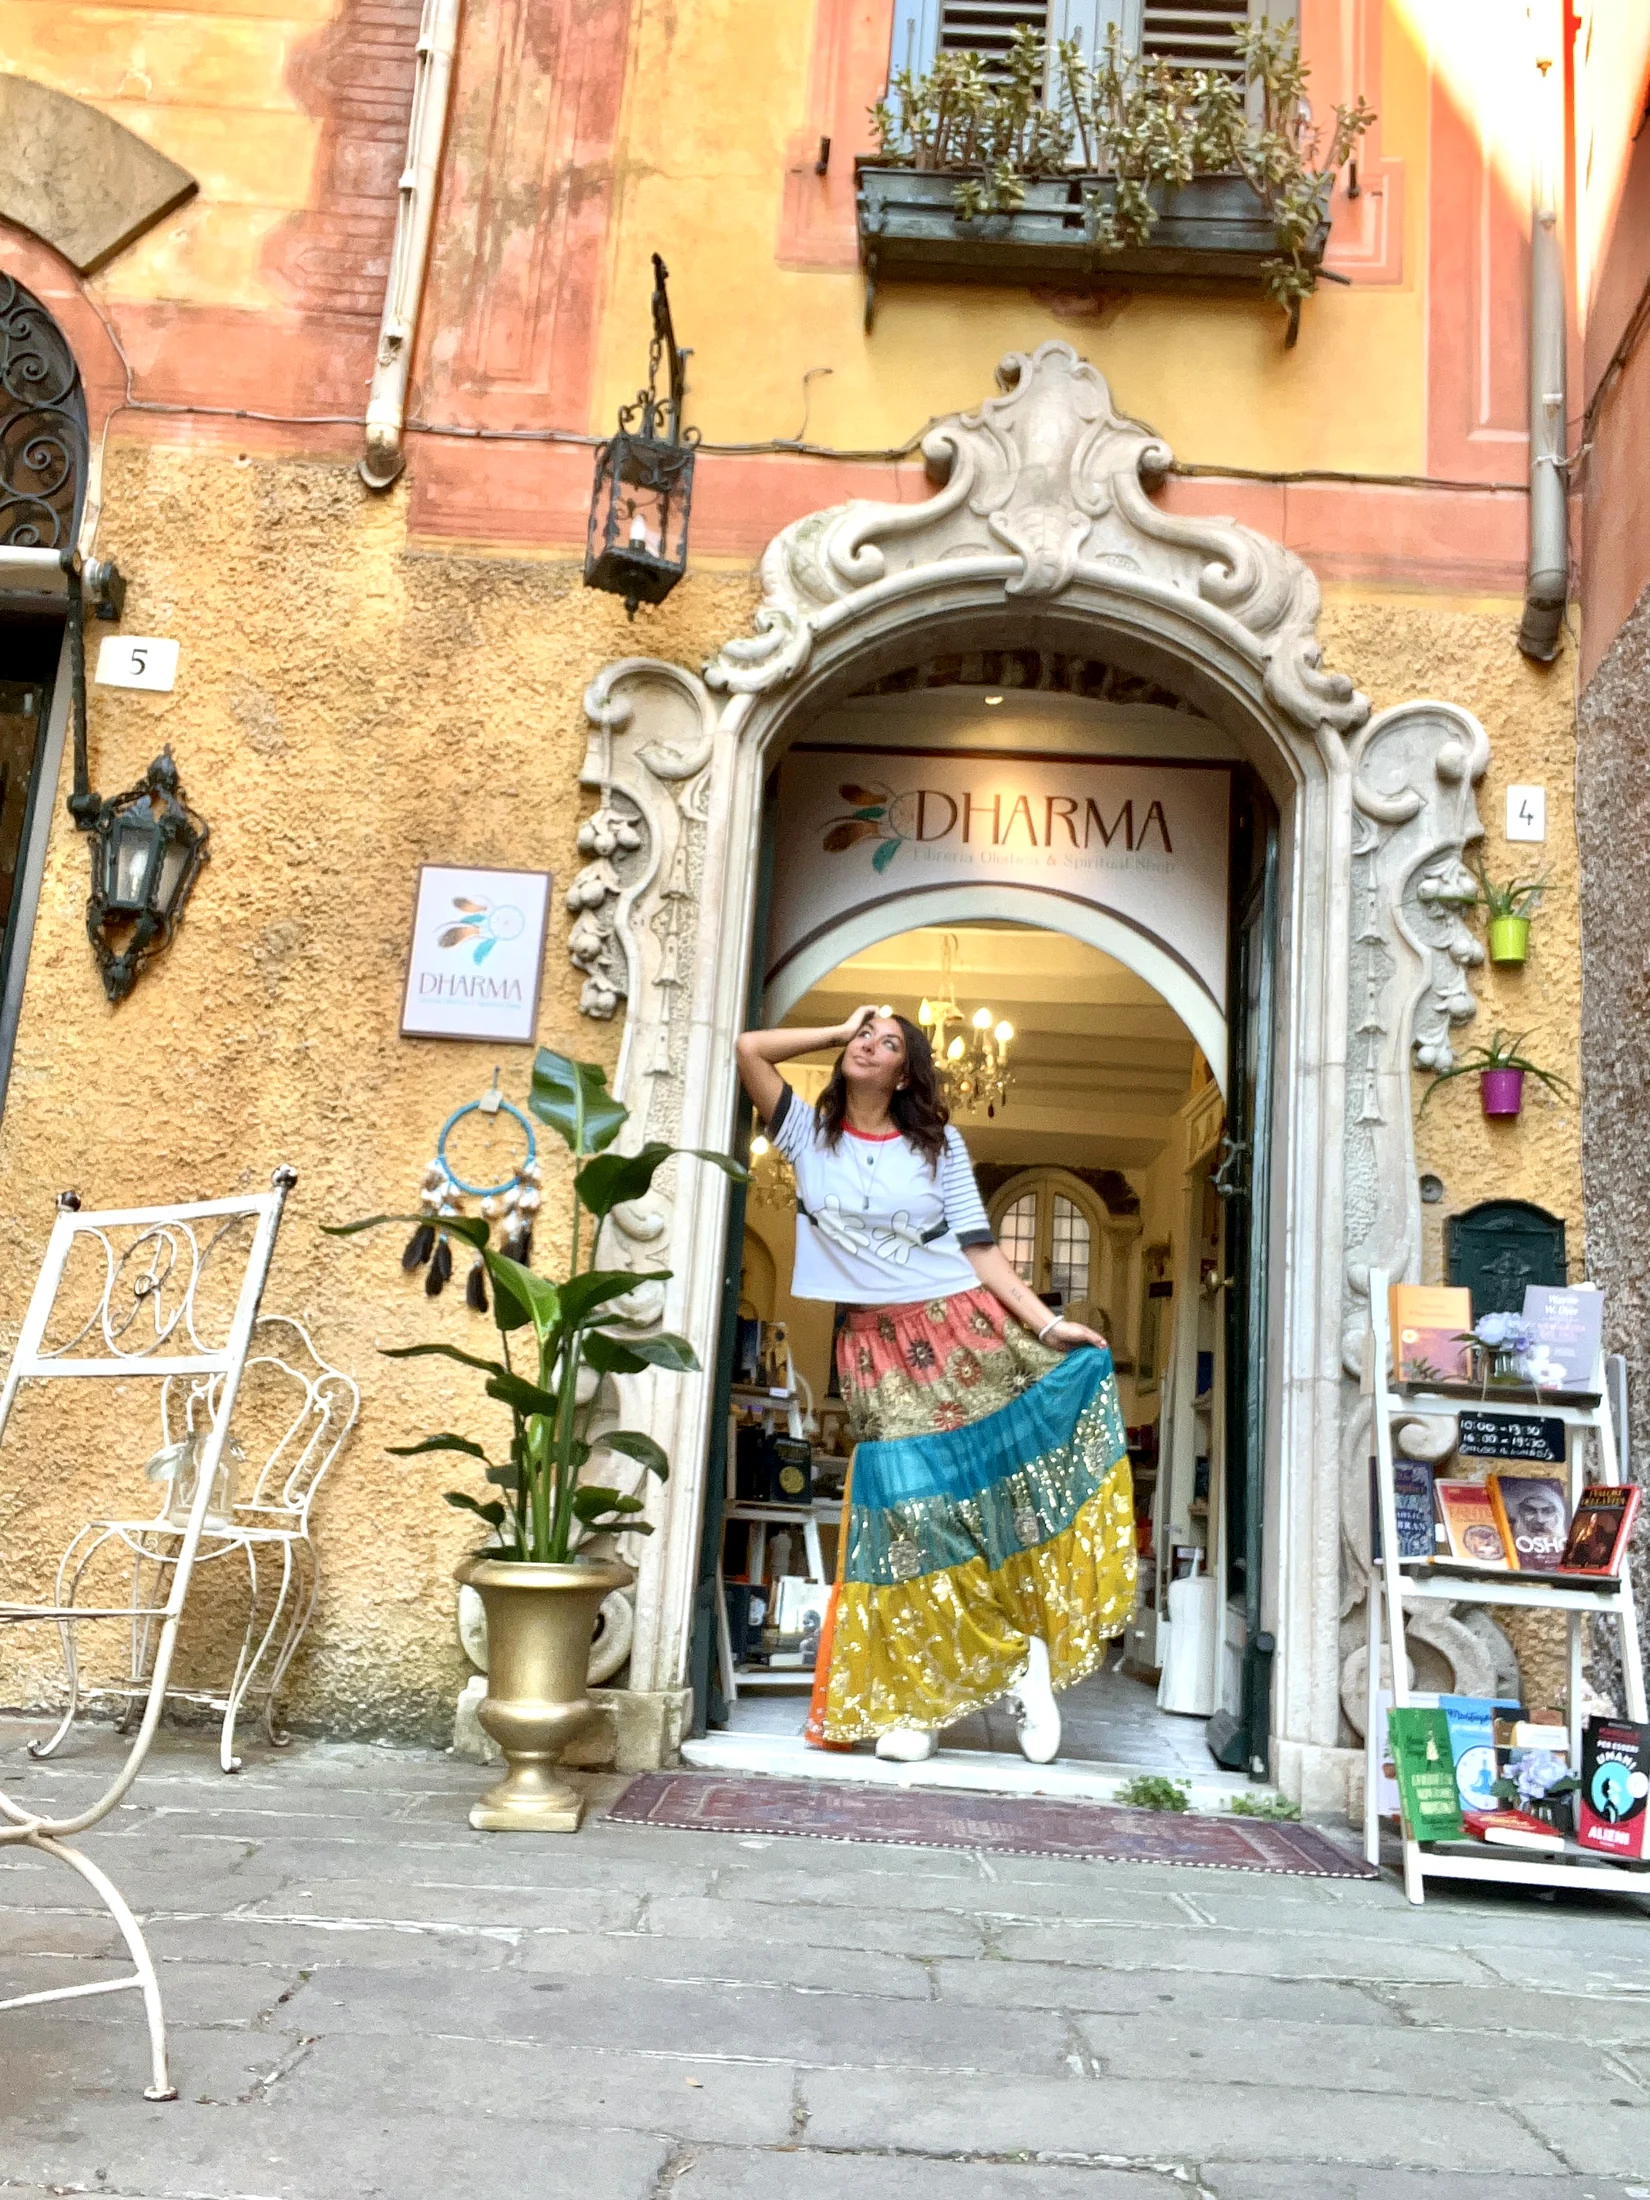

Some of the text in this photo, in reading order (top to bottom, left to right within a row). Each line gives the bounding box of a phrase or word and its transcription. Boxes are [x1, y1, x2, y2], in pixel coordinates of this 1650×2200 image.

[129, 649, 148, 675] 5
[916, 790, 1173, 853] DHARMA
[1519, 799, 1534, 826] 4
[1046, 855, 1057, 867] &
[419, 972, 522, 1001] DHARMA
[1461, 1420, 1496, 1432] 10:00
[1596, 1751, 1637, 1771] UMANI
[1588, 1825, 1630, 1846] ALIENI
